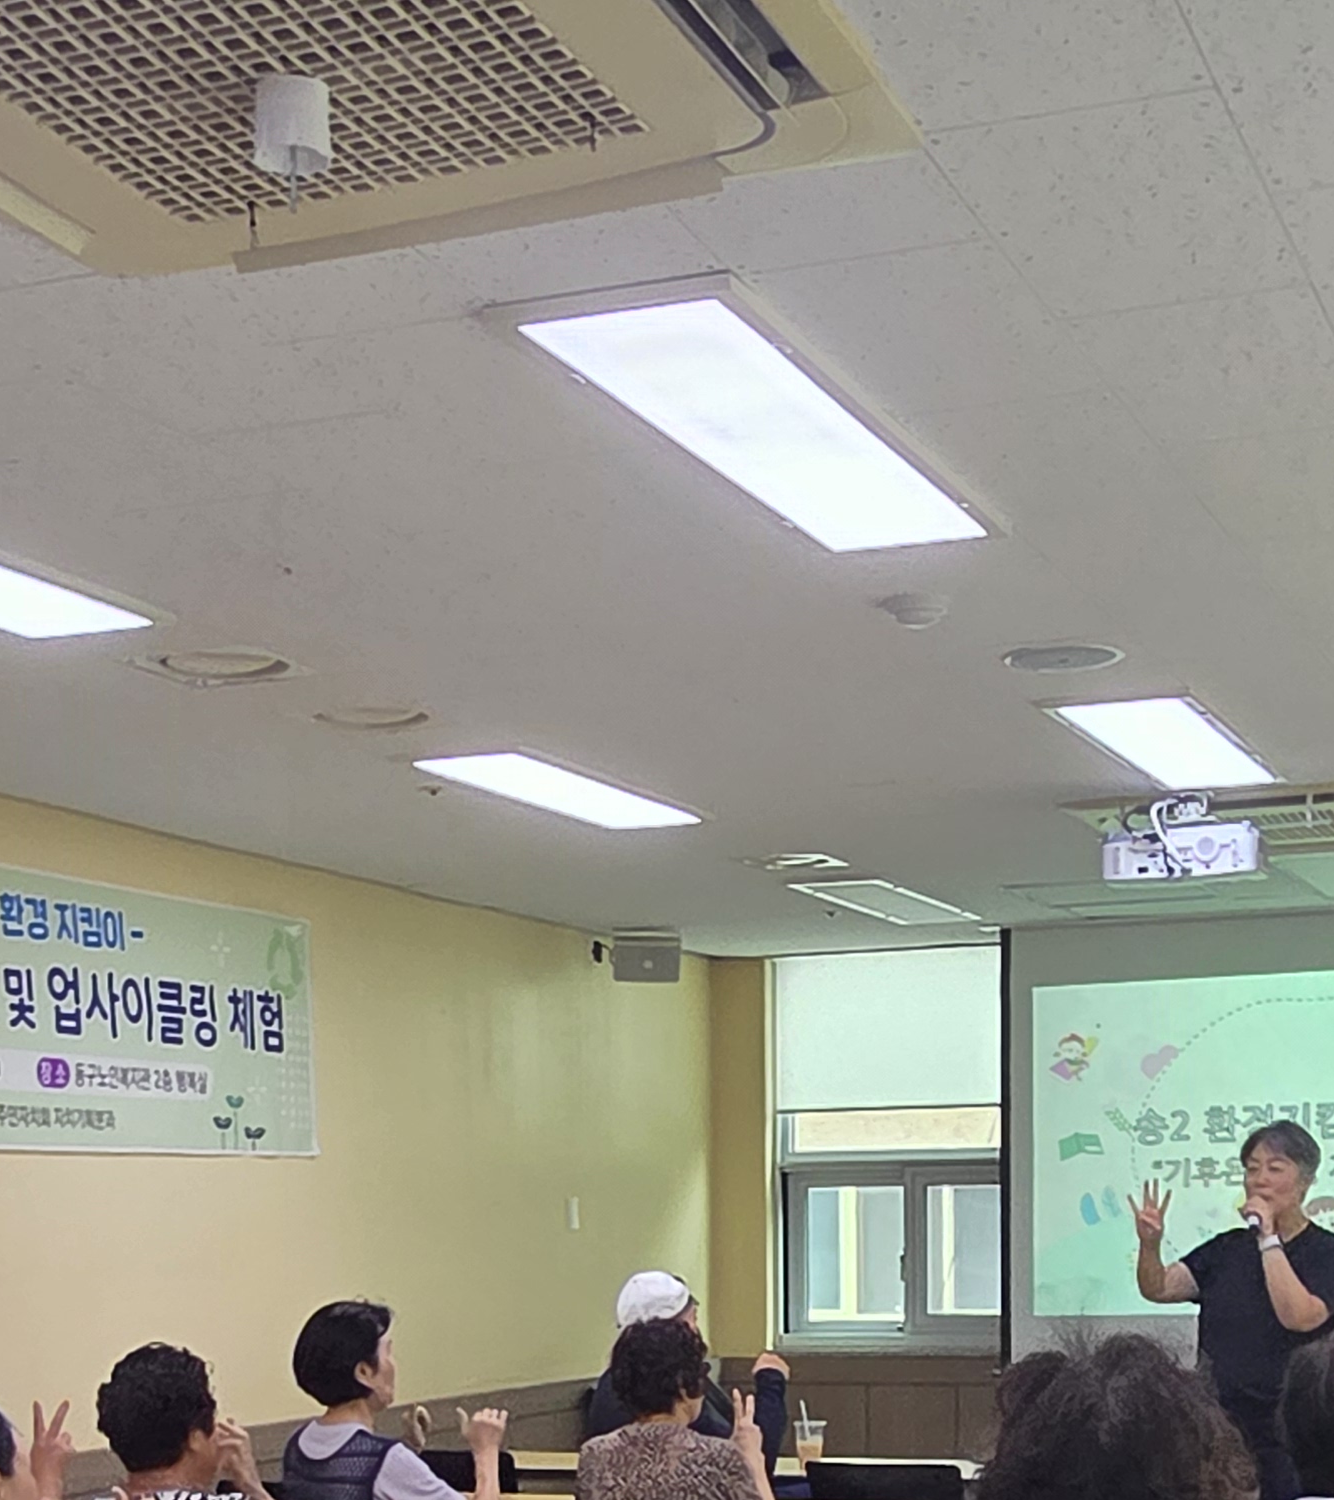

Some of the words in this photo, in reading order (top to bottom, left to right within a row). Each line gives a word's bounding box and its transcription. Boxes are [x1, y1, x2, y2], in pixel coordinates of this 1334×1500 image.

[53, 903, 125, 951] 지킴이
[3, 968, 36, 1030] 및
[47, 966, 217, 1048] 업사이클링
[227, 987, 284, 1053] 체험
[40, 1061, 67, 1086] 장소
[1134, 1107, 1191, 1146] 송2
